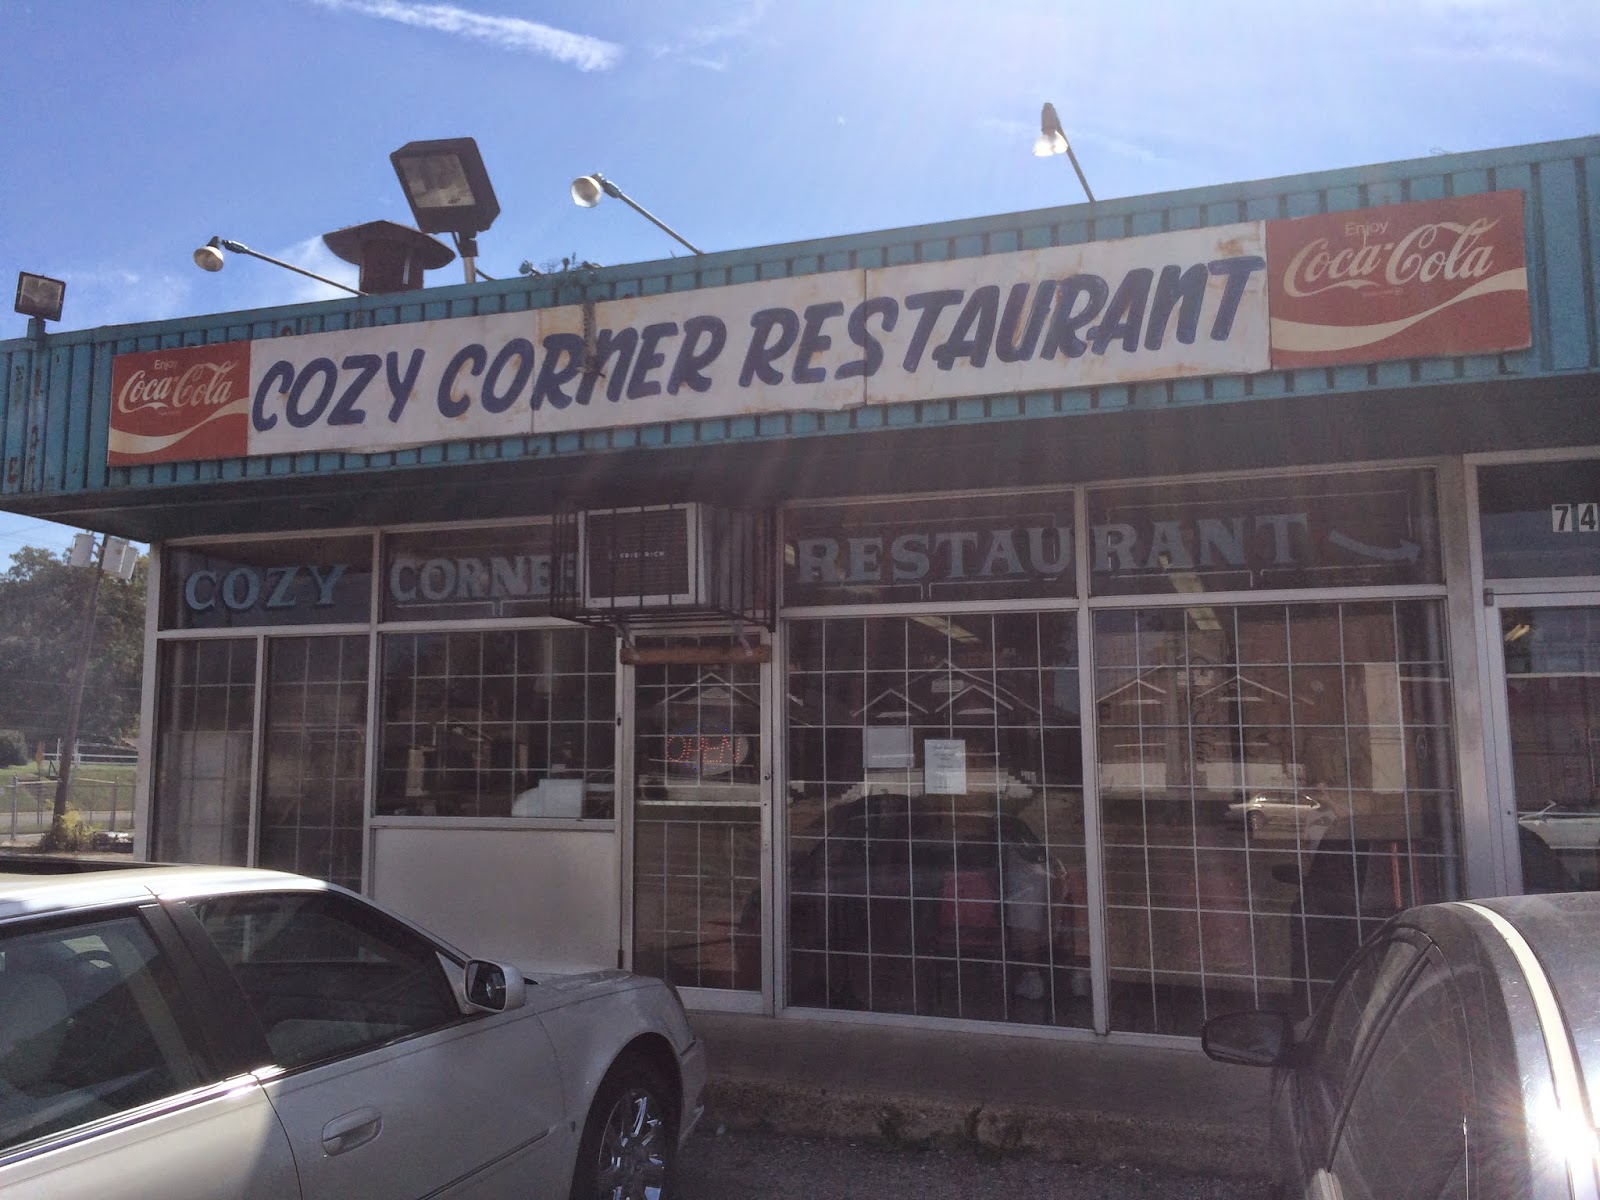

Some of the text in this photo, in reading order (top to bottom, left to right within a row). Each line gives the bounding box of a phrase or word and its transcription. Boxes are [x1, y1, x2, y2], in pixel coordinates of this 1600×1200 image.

[1344, 220, 1389, 237] Enjoy
[1283, 217, 1499, 297] Coca-Cola
[252, 255, 1265, 432] COZY CORNER RESTAURANT
[118, 361, 238, 413] Coca-Cola
[1554, 504, 1597, 531] 74
[185, 564, 349, 611] COZY
